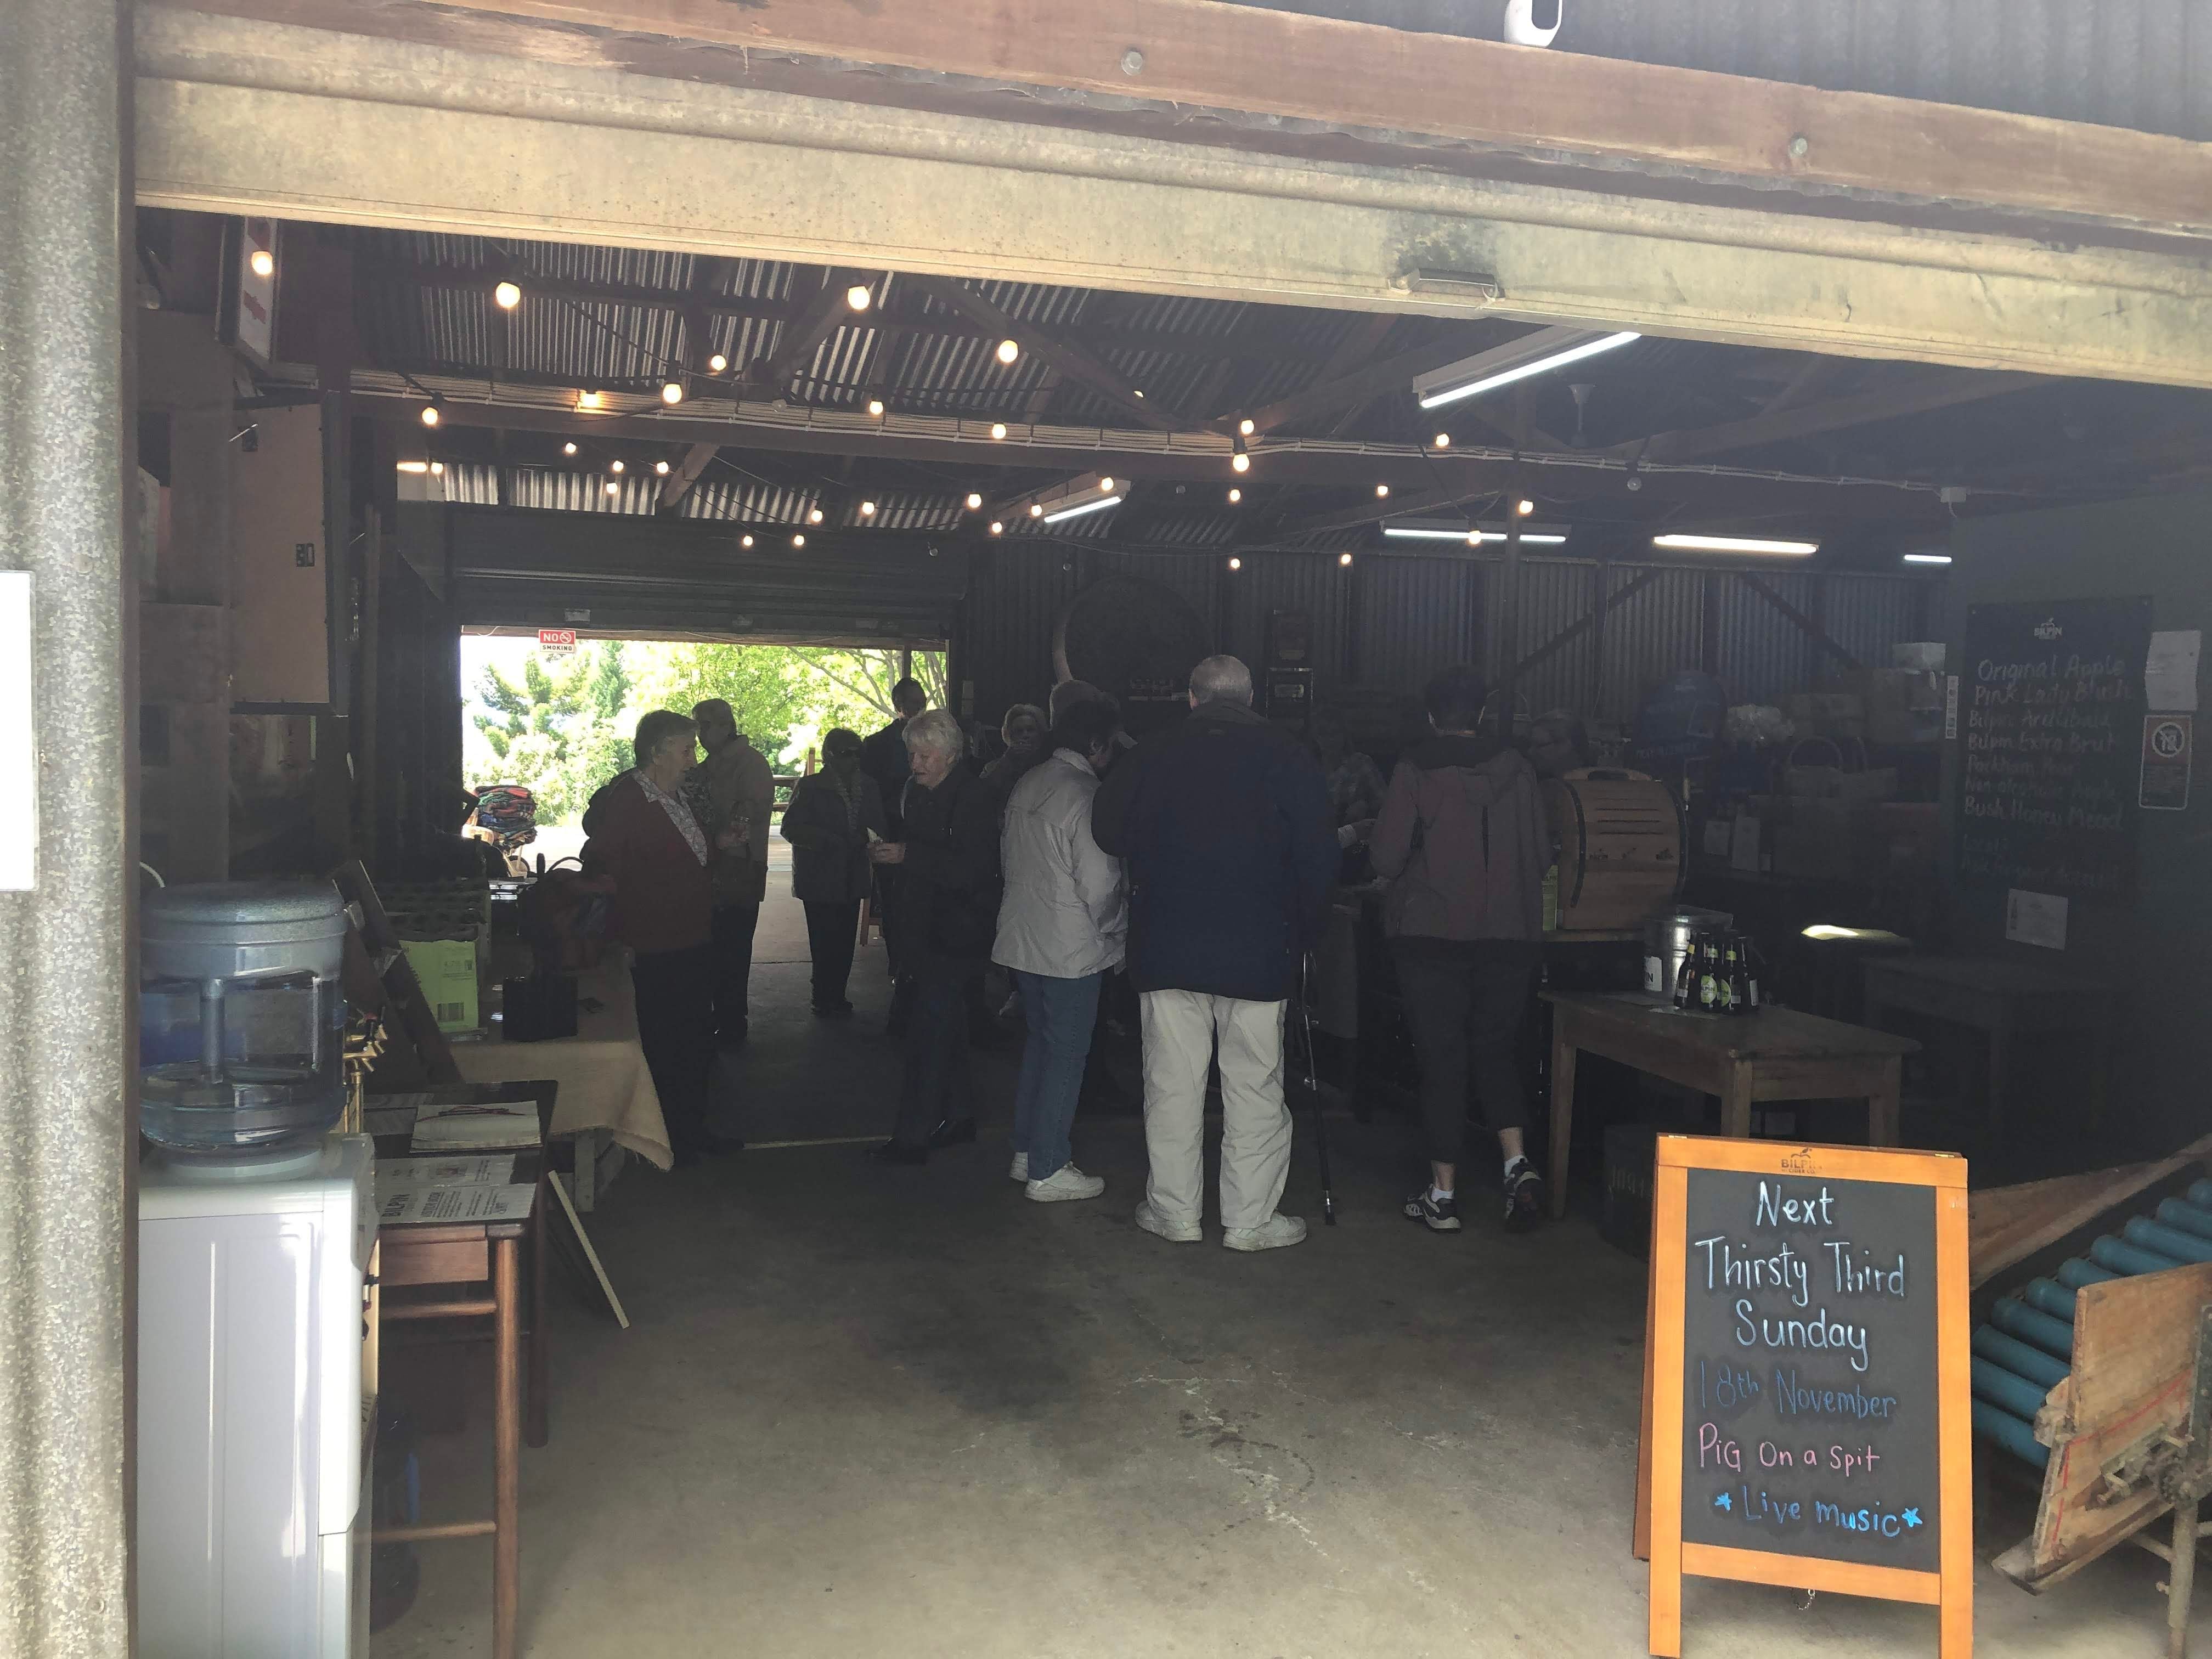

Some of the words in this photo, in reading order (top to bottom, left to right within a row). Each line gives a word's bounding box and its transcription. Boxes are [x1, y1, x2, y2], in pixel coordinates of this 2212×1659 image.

[543, 633, 558, 642] NO
[1977, 654, 2059, 687] Original
[2063, 653, 2126, 691] Apple
[1974, 682, 2019, 706] Pink
[1964, 795, 2006, 820] Bush
[381, 1194, 411, 1217] BILPIN
[1756, 1181, 1835, 1227] Next
[1694, 1235, 1809, 1307] Thirsty
[1823, 1241, 1905, 1296] Third
[1735, 1299, 1869, 1372] Sunday
[1700, 1361, 1759, 1409] 18th
[1776, 1369, 1897, 1419] November
[1759, 1441, 1793, 1468] On
[1803, 1449, 1818, 1466] a
[1742, 1485, 1801, 1524] Live
[1814, 1499, 1900, 1538] music
